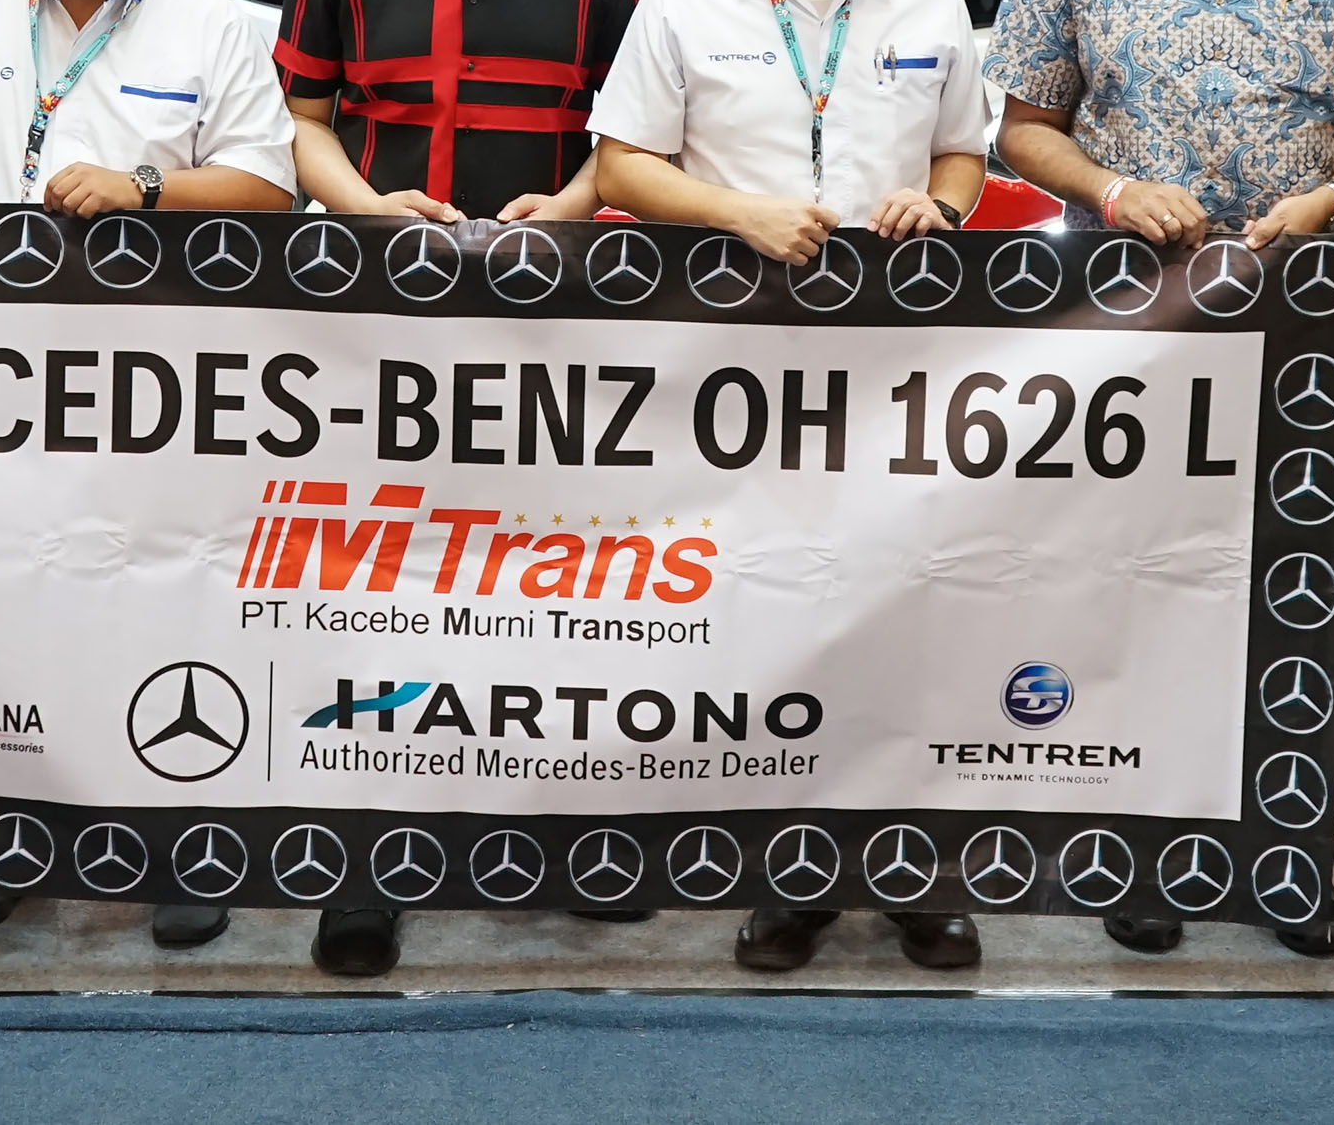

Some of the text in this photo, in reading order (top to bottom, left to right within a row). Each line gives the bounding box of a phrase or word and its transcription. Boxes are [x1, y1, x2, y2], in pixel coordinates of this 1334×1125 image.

[708, 54, 760, 62] TENTREM
[693, 366, 850, 473] OH
[888, 370, 1146, 480] 1626
[1184, 377, 1237, 476] L
[241, 601, 711, 650] PT. Kacebe Murni Transport
[300, 678, 824, 743] HARTONO
[300, 740, 819, 780] Authorized Mercedes-Benz Dealer
[928, 743, 1141, 769] TENTREM
[957, 773, 1110, 786] THE DYNAMIC TECHNOLOGY
